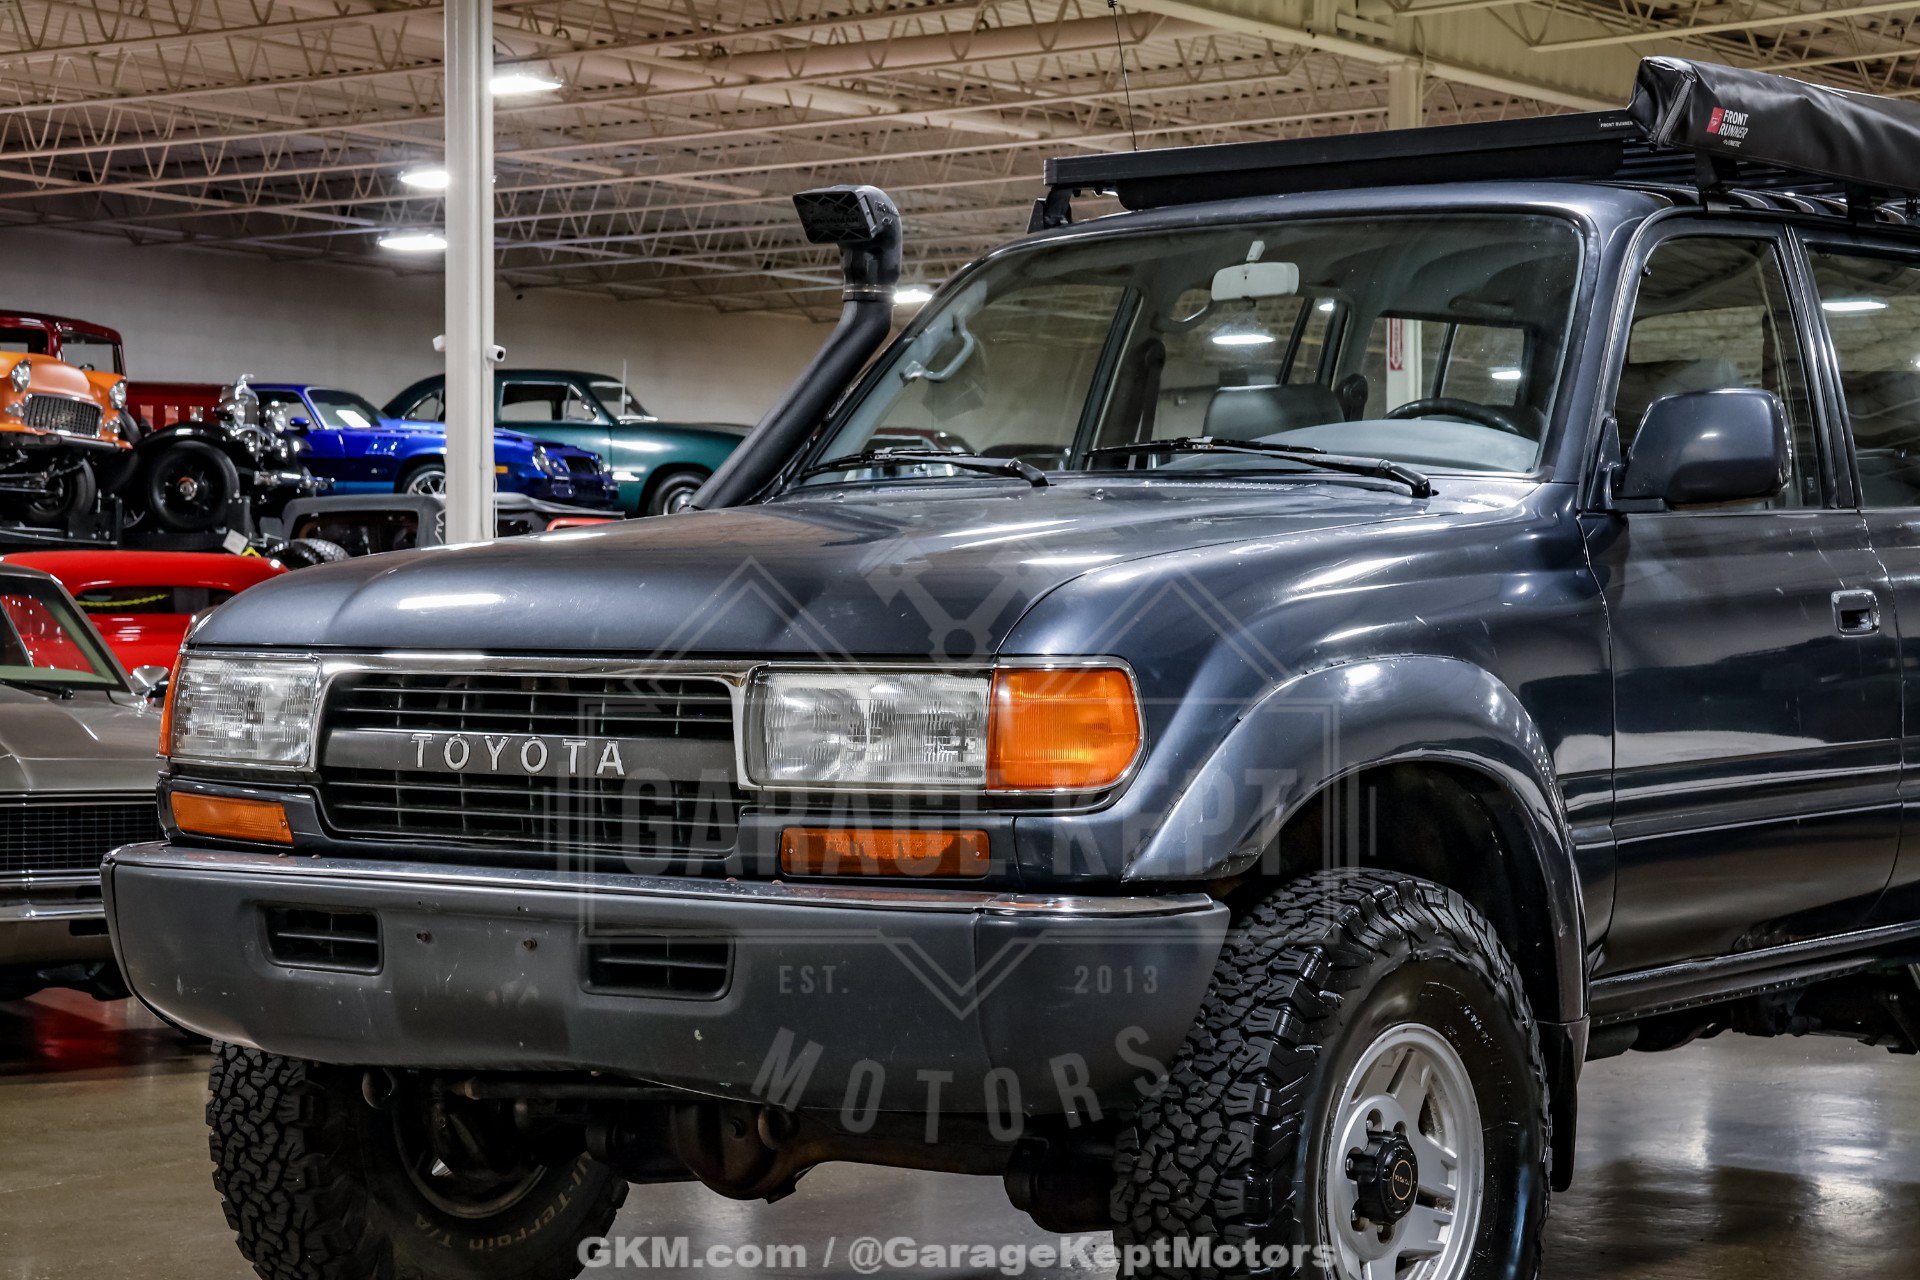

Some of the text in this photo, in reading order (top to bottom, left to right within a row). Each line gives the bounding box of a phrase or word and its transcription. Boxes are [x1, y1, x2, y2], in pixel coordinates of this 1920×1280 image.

[1723, 109, 1749, 126] FRONT
[1718, 123, 1749, 139] RUNNER
[410, 733, 625, 776] TOYOTA
